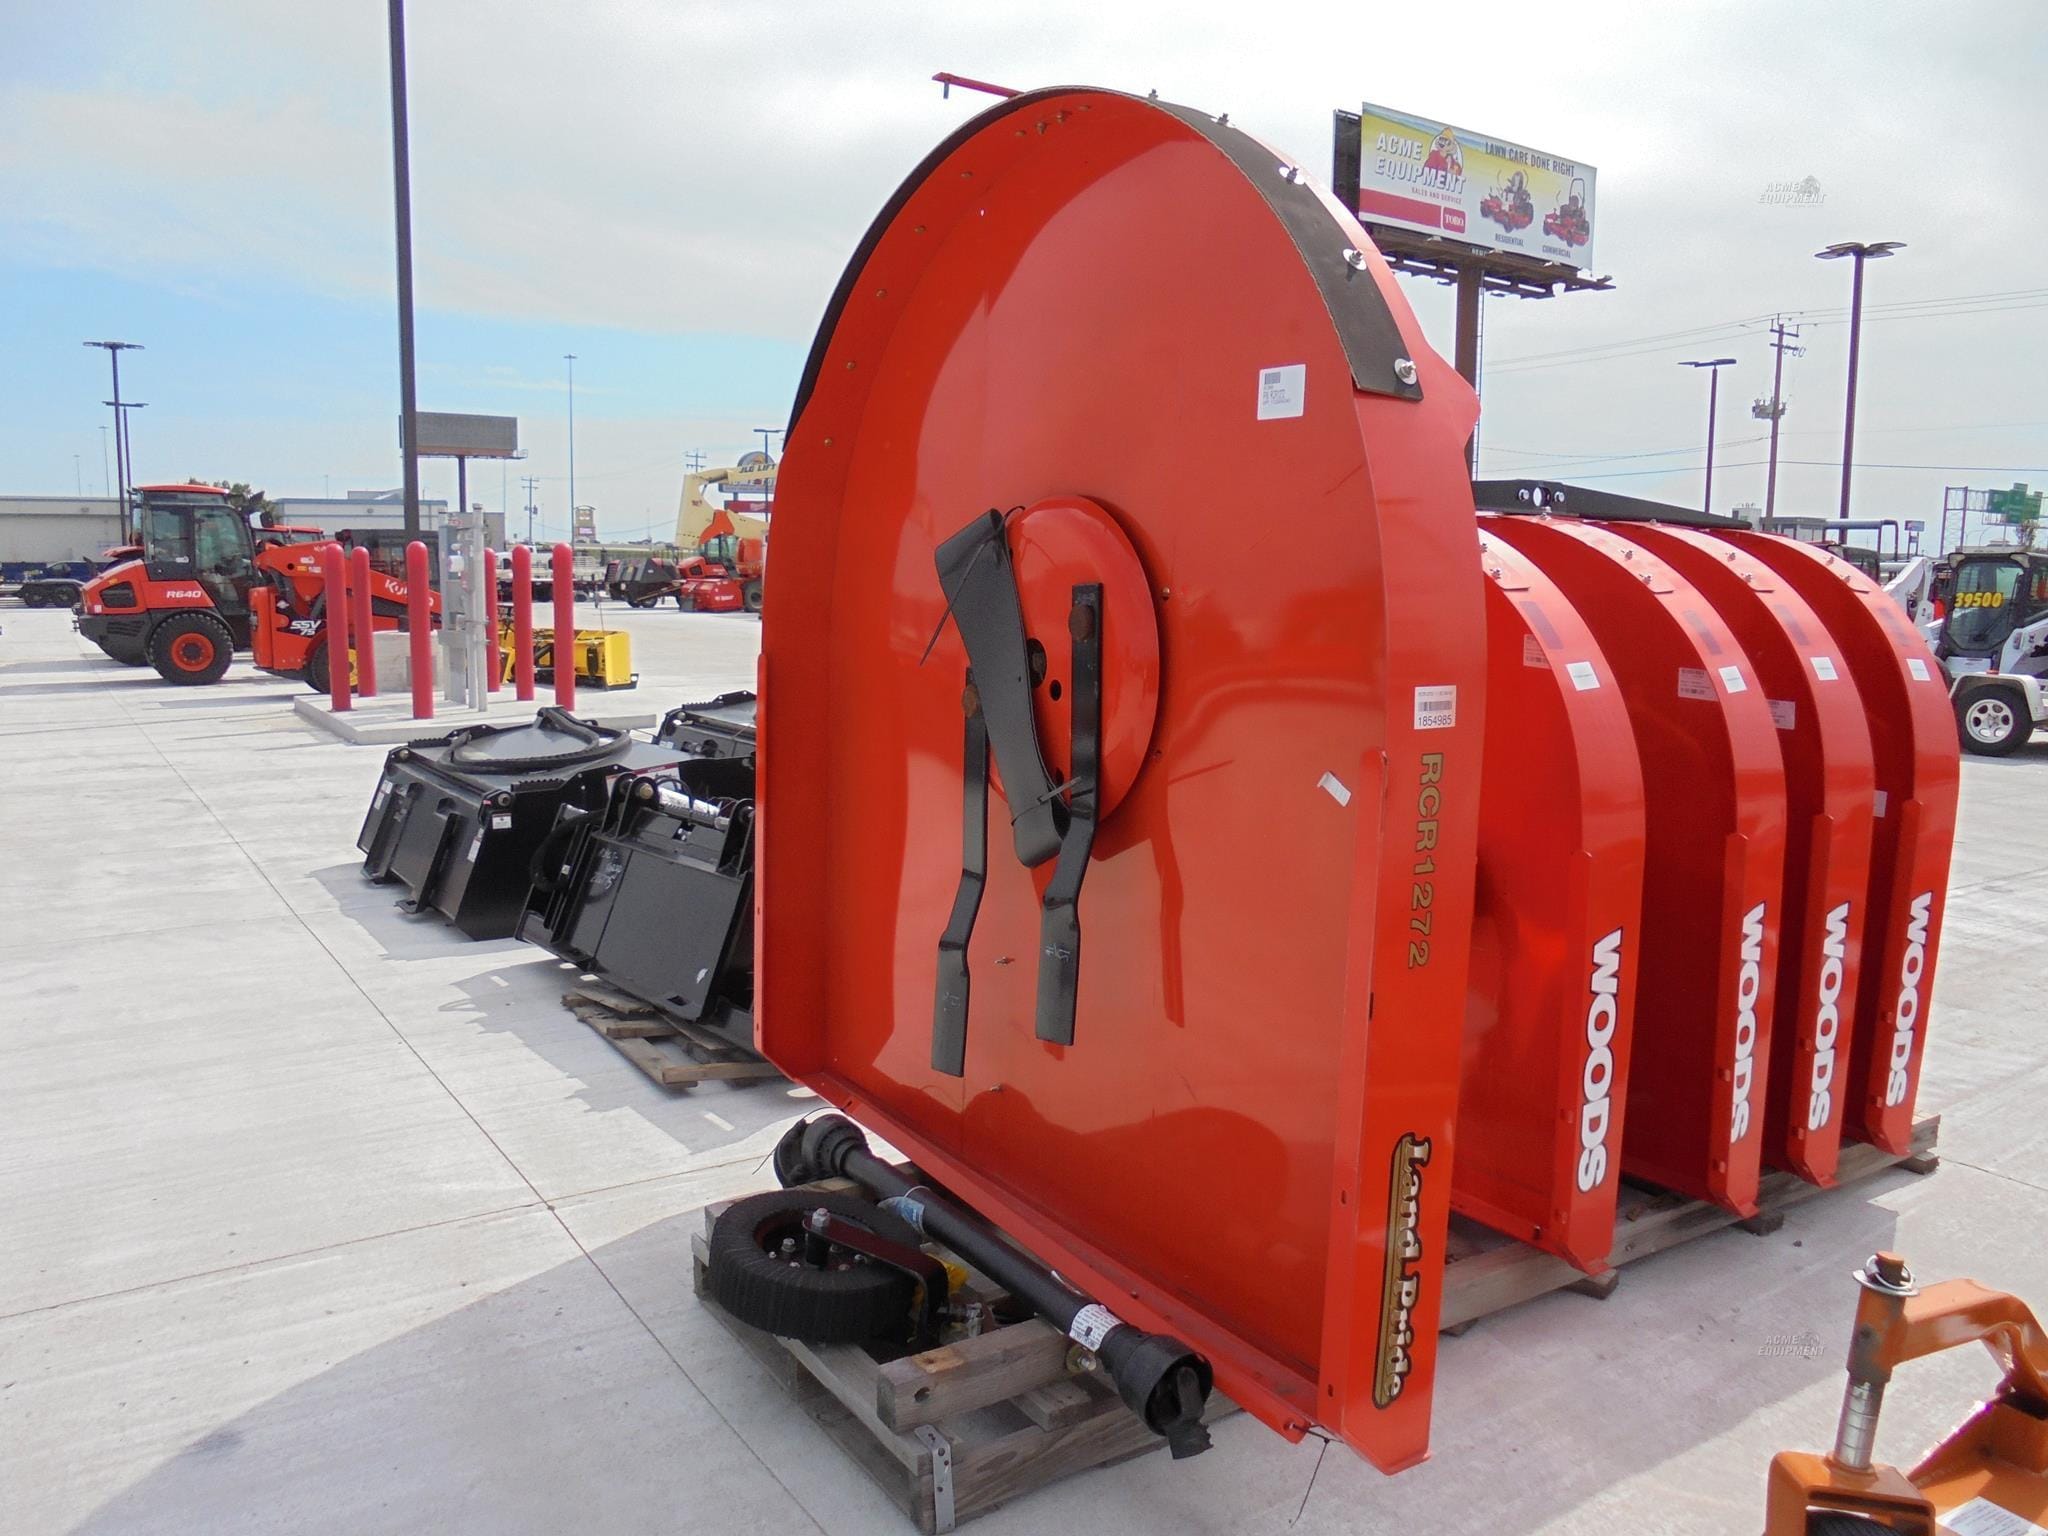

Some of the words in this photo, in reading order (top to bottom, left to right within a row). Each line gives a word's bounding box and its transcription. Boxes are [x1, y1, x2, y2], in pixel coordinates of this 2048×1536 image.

[1377, 133, 1423, 161] ACME
[1485, 142, 1507, 160] LAWN
[1508, 148, 1529, 165] CARE
[1530, 154, 1551, 171] DONE
[1552, 160, 1575, 177] RIGHT
[1375, 157, 1466, 194] EQUIPMENT
[166, 590, 202, 599] R640
[1953, 591, 2004, 608] 39500
[290, 620, 322, 630] SSV
[300, 628, 316, 636] 75
[1418, 715, 1453, 727] 1854985
[1407, 752, 1444, 969] RCR1272
[1807, 901, 1850, 1131] WOODS
[1885, 891, 1932, 1107] WOODS
[1730, 900, 1766, 1143] WOODS
[1576, 927, 1623, 1193] WOODS
[1397, 1134, 1431, 1262] Land
[1384, 1270, 1420, 1399] Pride
